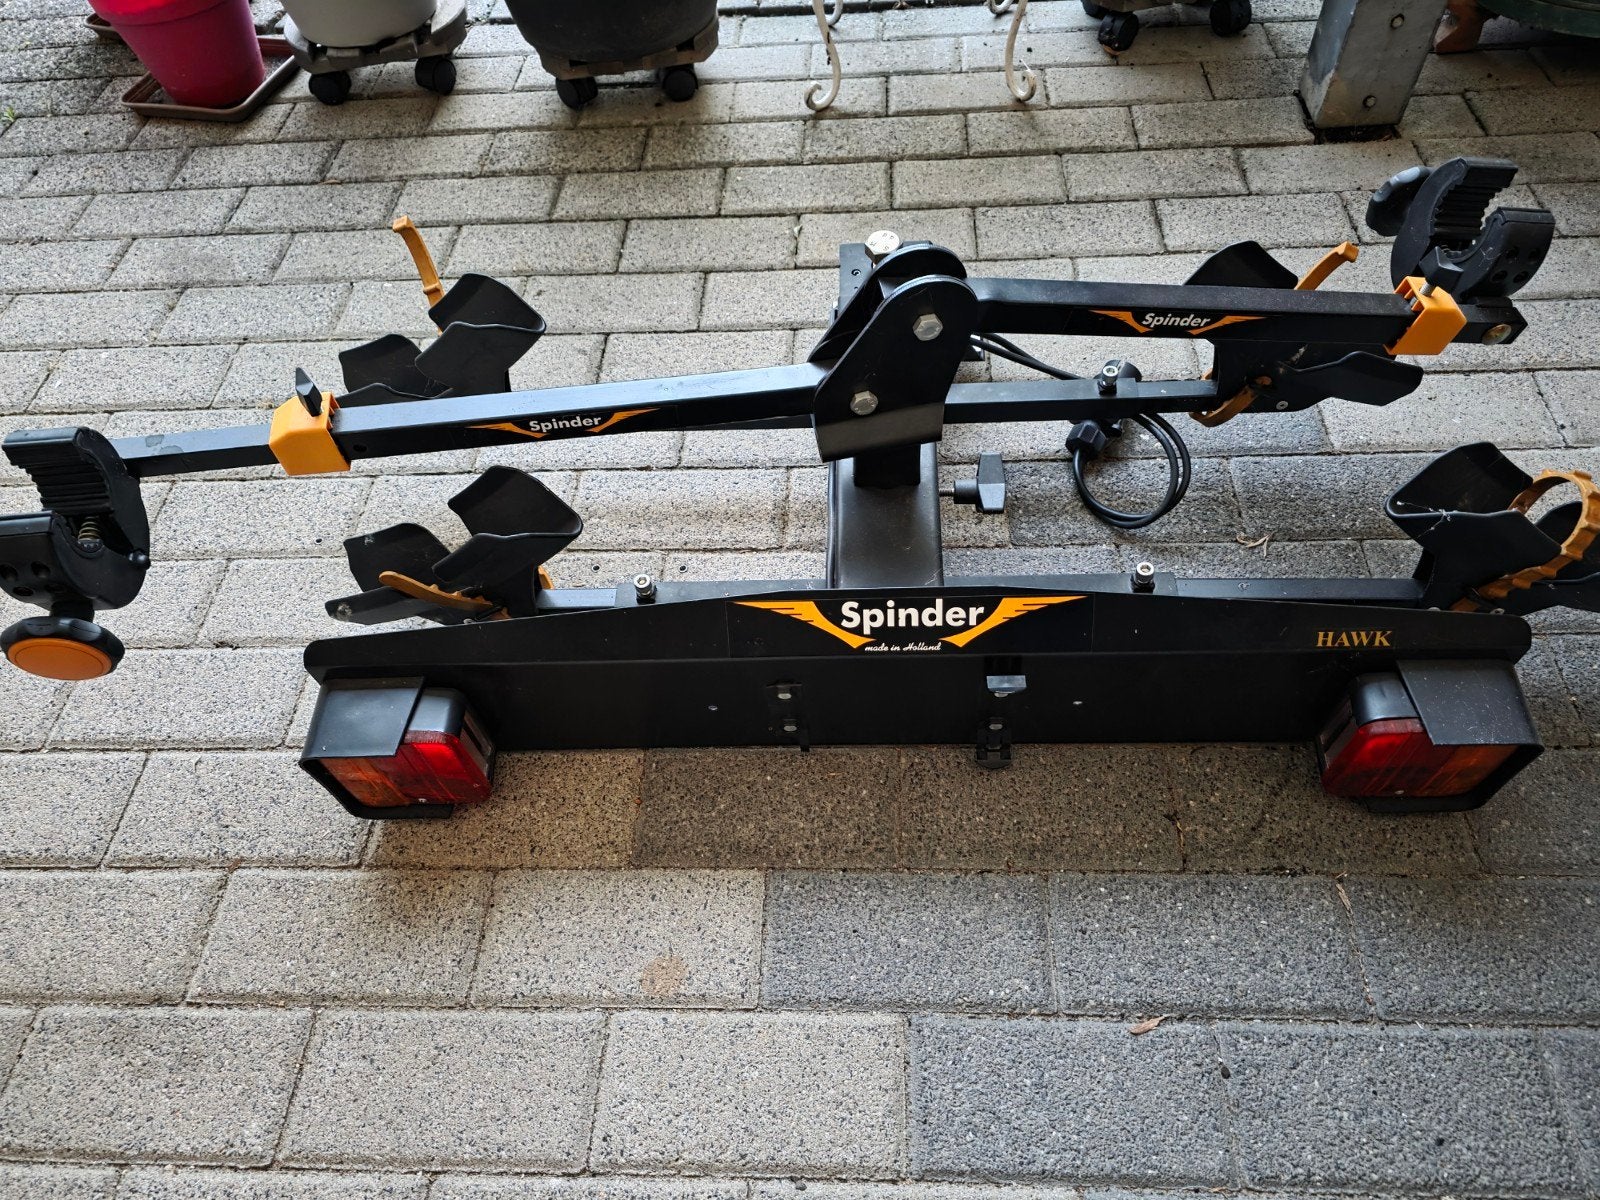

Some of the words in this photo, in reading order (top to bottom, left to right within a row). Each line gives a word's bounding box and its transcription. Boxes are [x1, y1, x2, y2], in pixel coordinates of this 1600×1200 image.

[1141, 312, 1211, 328] Spinder
[529, 414, 602, 433] Spinder
[840, 598, 985, 635] Spinder
[864, 642, 889, 652] made
[890, 644, 901, 652] in
[902, 641, 942, 652] Holland
[1316, 630, 1393, 647] HAWK
